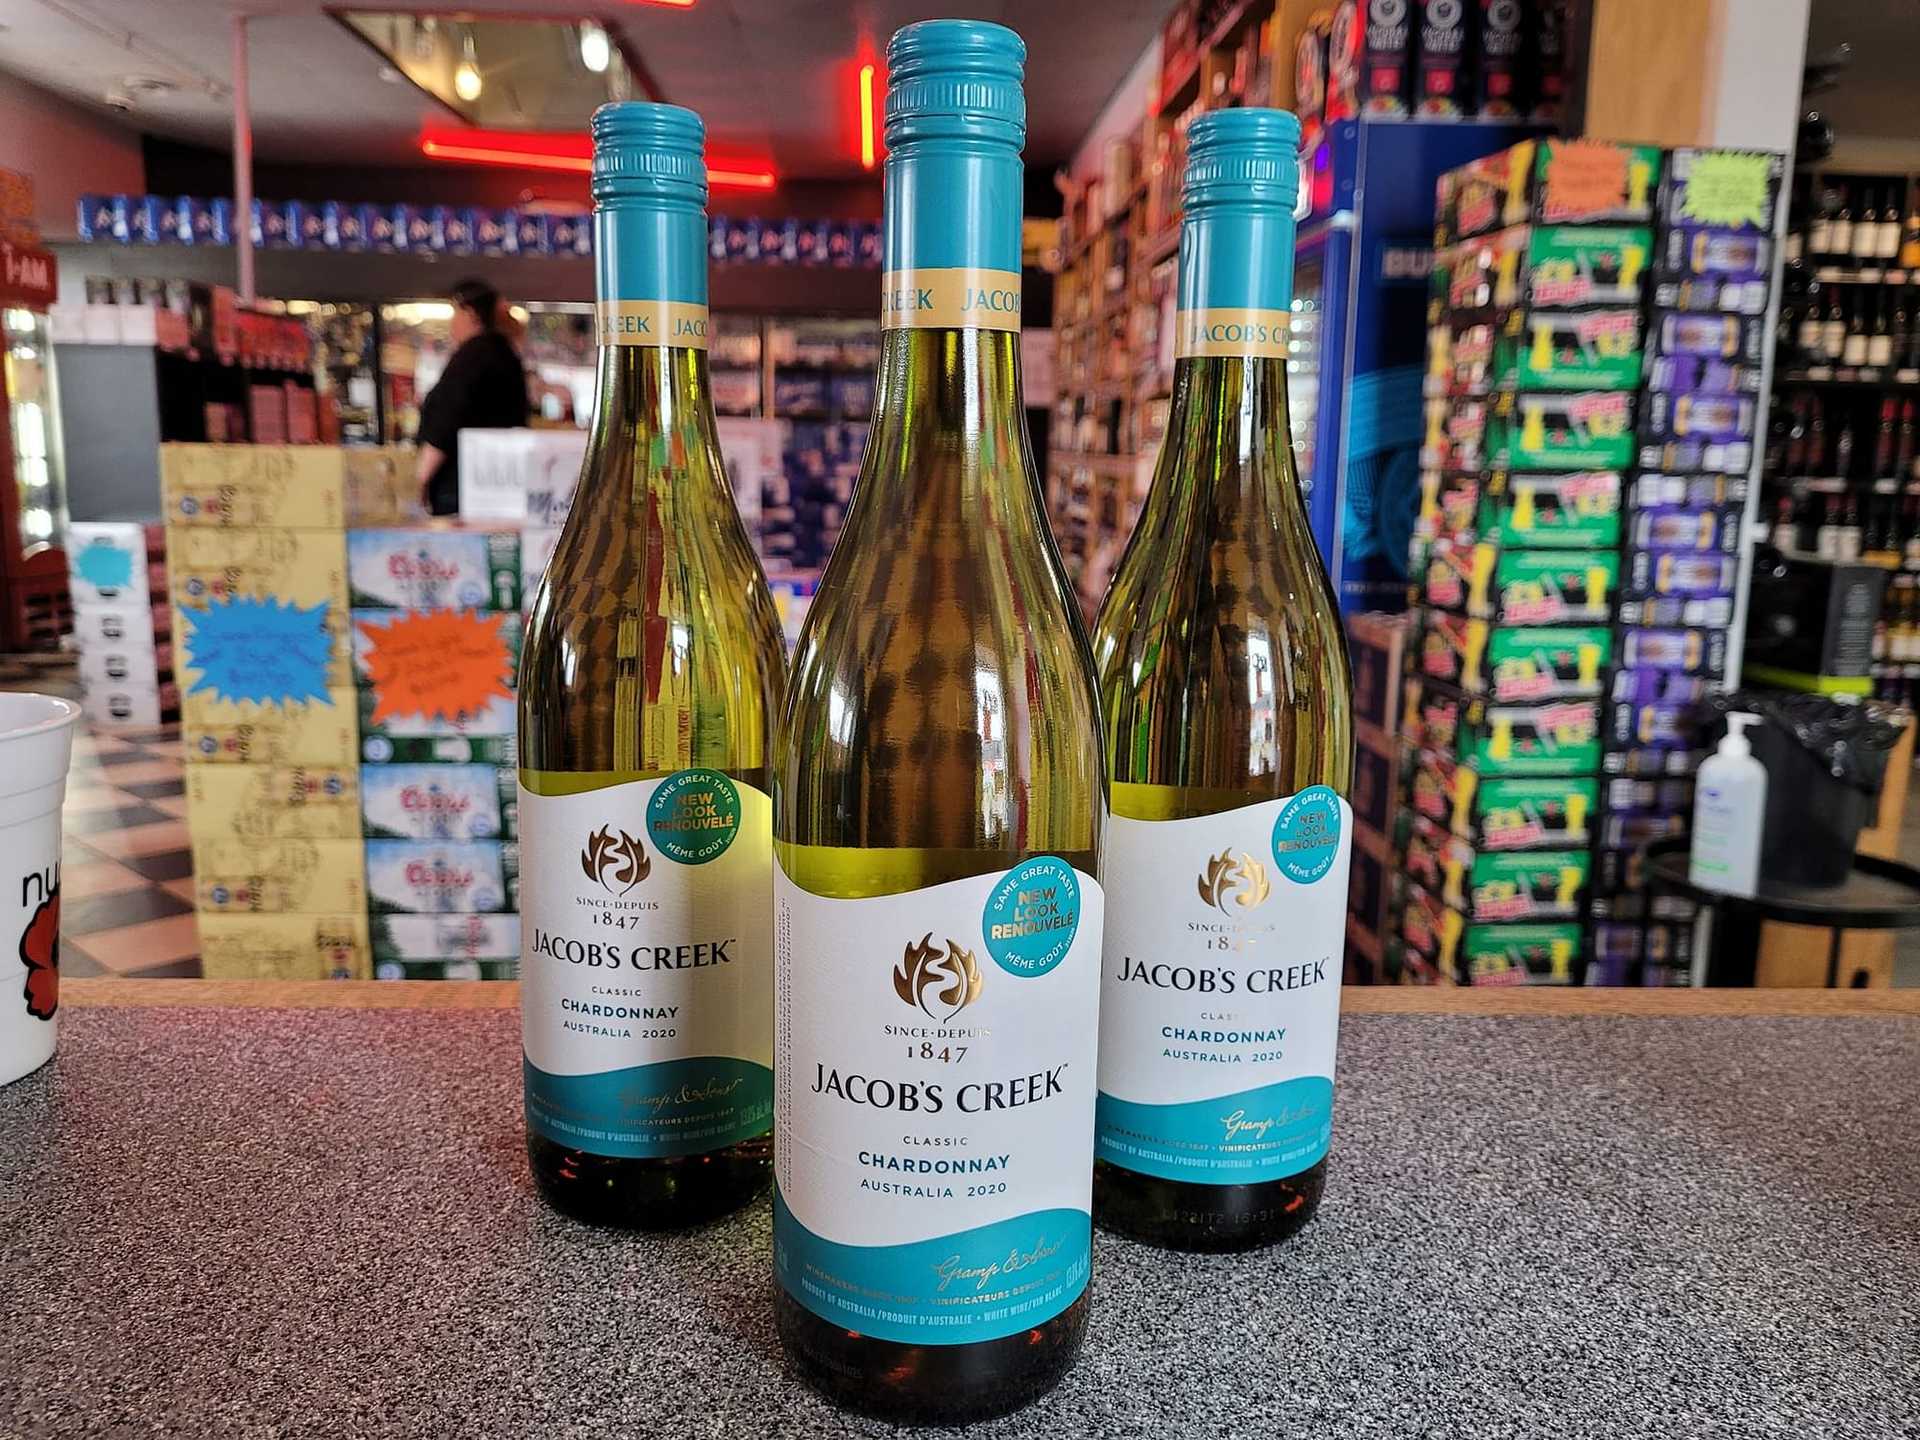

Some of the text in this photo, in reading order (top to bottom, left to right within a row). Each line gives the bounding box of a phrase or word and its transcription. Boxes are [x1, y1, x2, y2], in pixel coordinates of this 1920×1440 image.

[883, 289, 933, 312] REEK
[602, 315, 650, 333] REEK
[655, 775, 734, 809] SAME GREAT TASTE
[678, 792, 714, 806] NEW
[994, 865, 1076, 911] SAME GREAT TASTE
[1018, 886, 1057, 905] NEW
[593, 911, 640, 930] 1847
[1014, 902, 1059, 922] LOOK
[991, 908, 1075, 940] RENOUVELÉ
[533, 928, 620, 970] JACOB'S
[1005, 951, 1035, 969] MÊME
[1117, 957, 1236, 993] JACOB'S
[592, 986, 641, 997] CLASSIC
[561, 999, 679, 1019] CHARDONNAY
[563, 1021, 676, 1038] AUSTRALIA 2020
[1162, 1026, 1286, 1043] CHARDONNAY
[907, 1042, 968, 1063] 1847
[1163, 1048, 1283, 1063] AUSTRALIA 2020
[811, 1063, 943, 1114] JACOB'S
[903, 1135, 969, 1146] CLASSIC
[858, 1151, 1010, 1174] CHARDONNAY
[860, 1179, 1007, 1198] AUSTRALIA 2020
